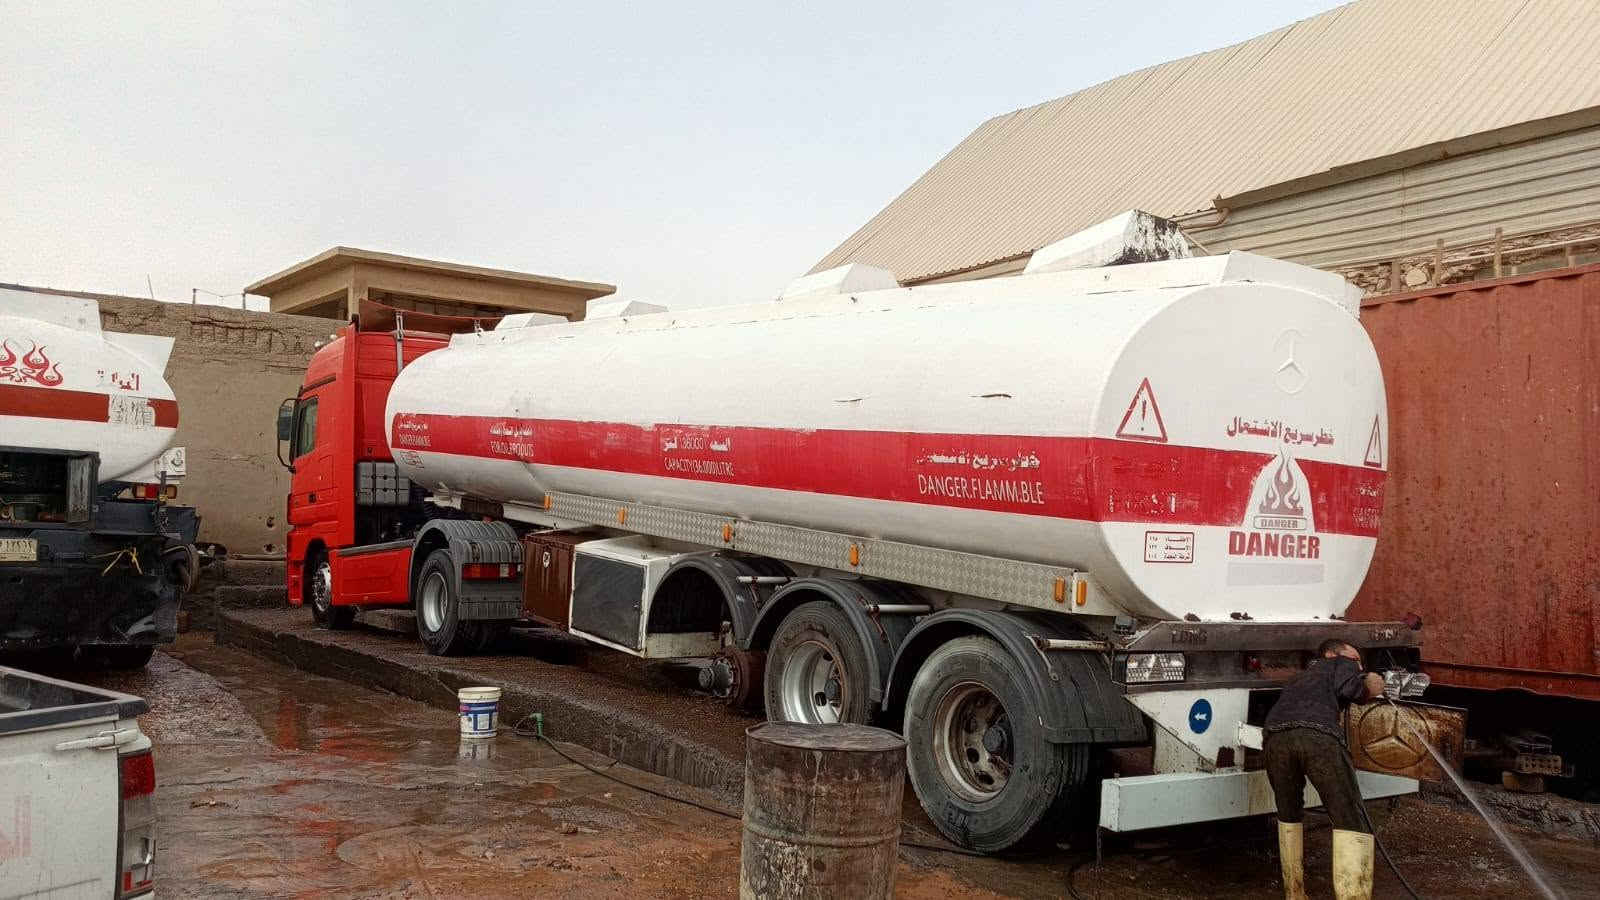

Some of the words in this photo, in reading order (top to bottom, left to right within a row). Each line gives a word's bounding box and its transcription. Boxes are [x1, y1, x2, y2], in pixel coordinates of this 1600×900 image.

[1284, 427, 1314, 445] سريع
[1313, 427, 1336, 446] خطر
[1260, 518, 1299, 529] DANGER
[1228, 530, 1321, 560] DANGER
